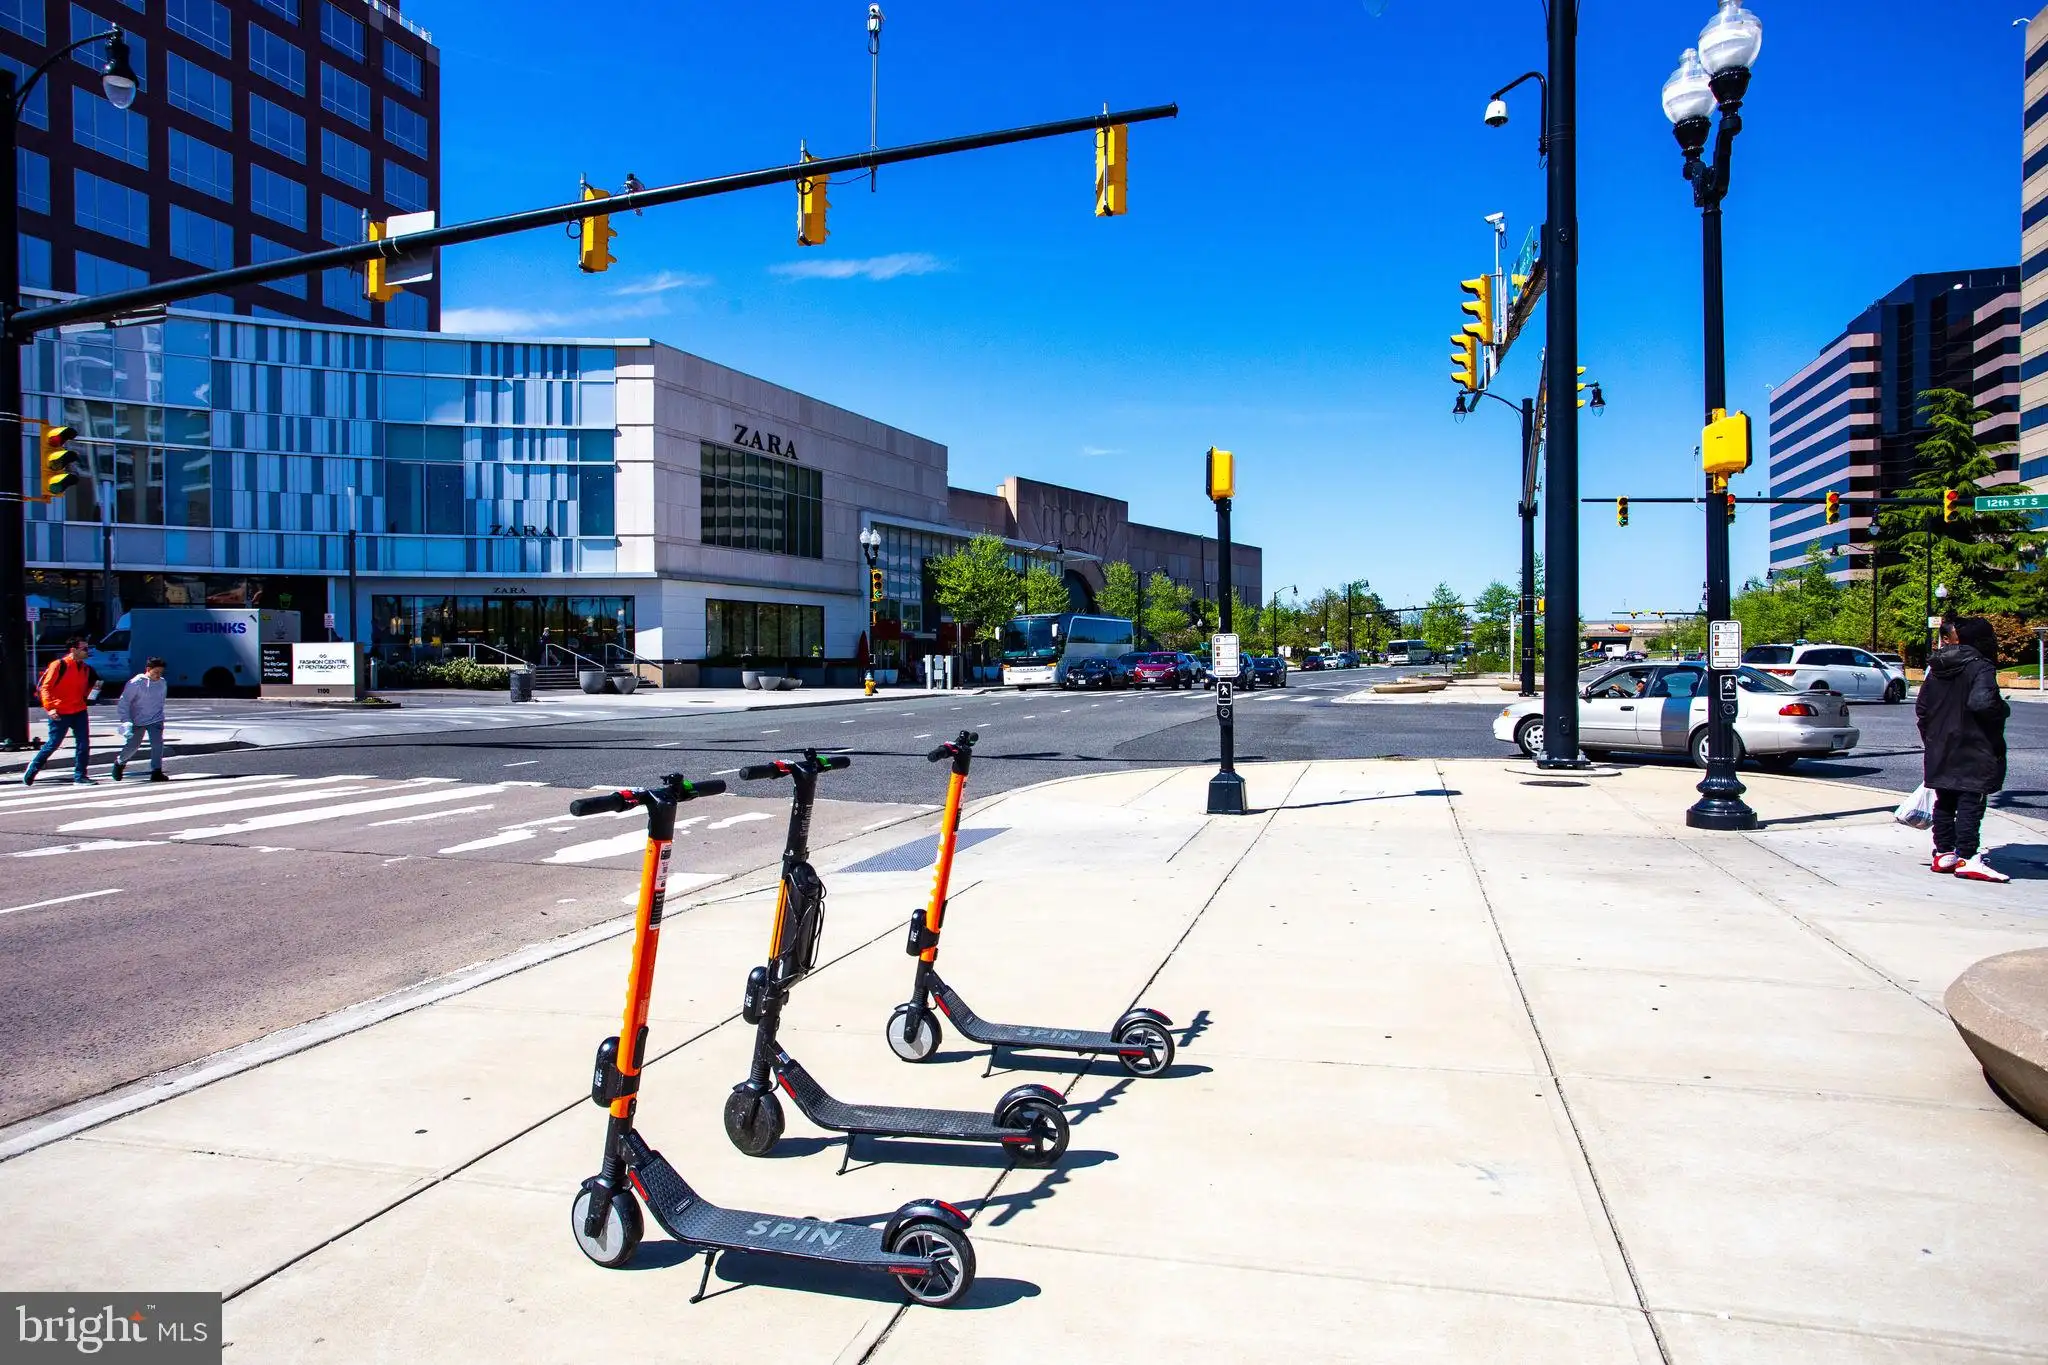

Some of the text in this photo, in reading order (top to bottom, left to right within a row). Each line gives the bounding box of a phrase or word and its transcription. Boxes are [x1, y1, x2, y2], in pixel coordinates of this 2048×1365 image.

[734, 424, 799, 460] ZARA
[1986, 499, 2009, 507] 12th
[2013, 498, 2027, 506] ST
[489, 524, 557, 537] ZARA
[194, 622, 247, 634] BRINKS
[1016, 1028, 1081, 1040] SPIN
[746, 1220, 843, 1245] SPIN
